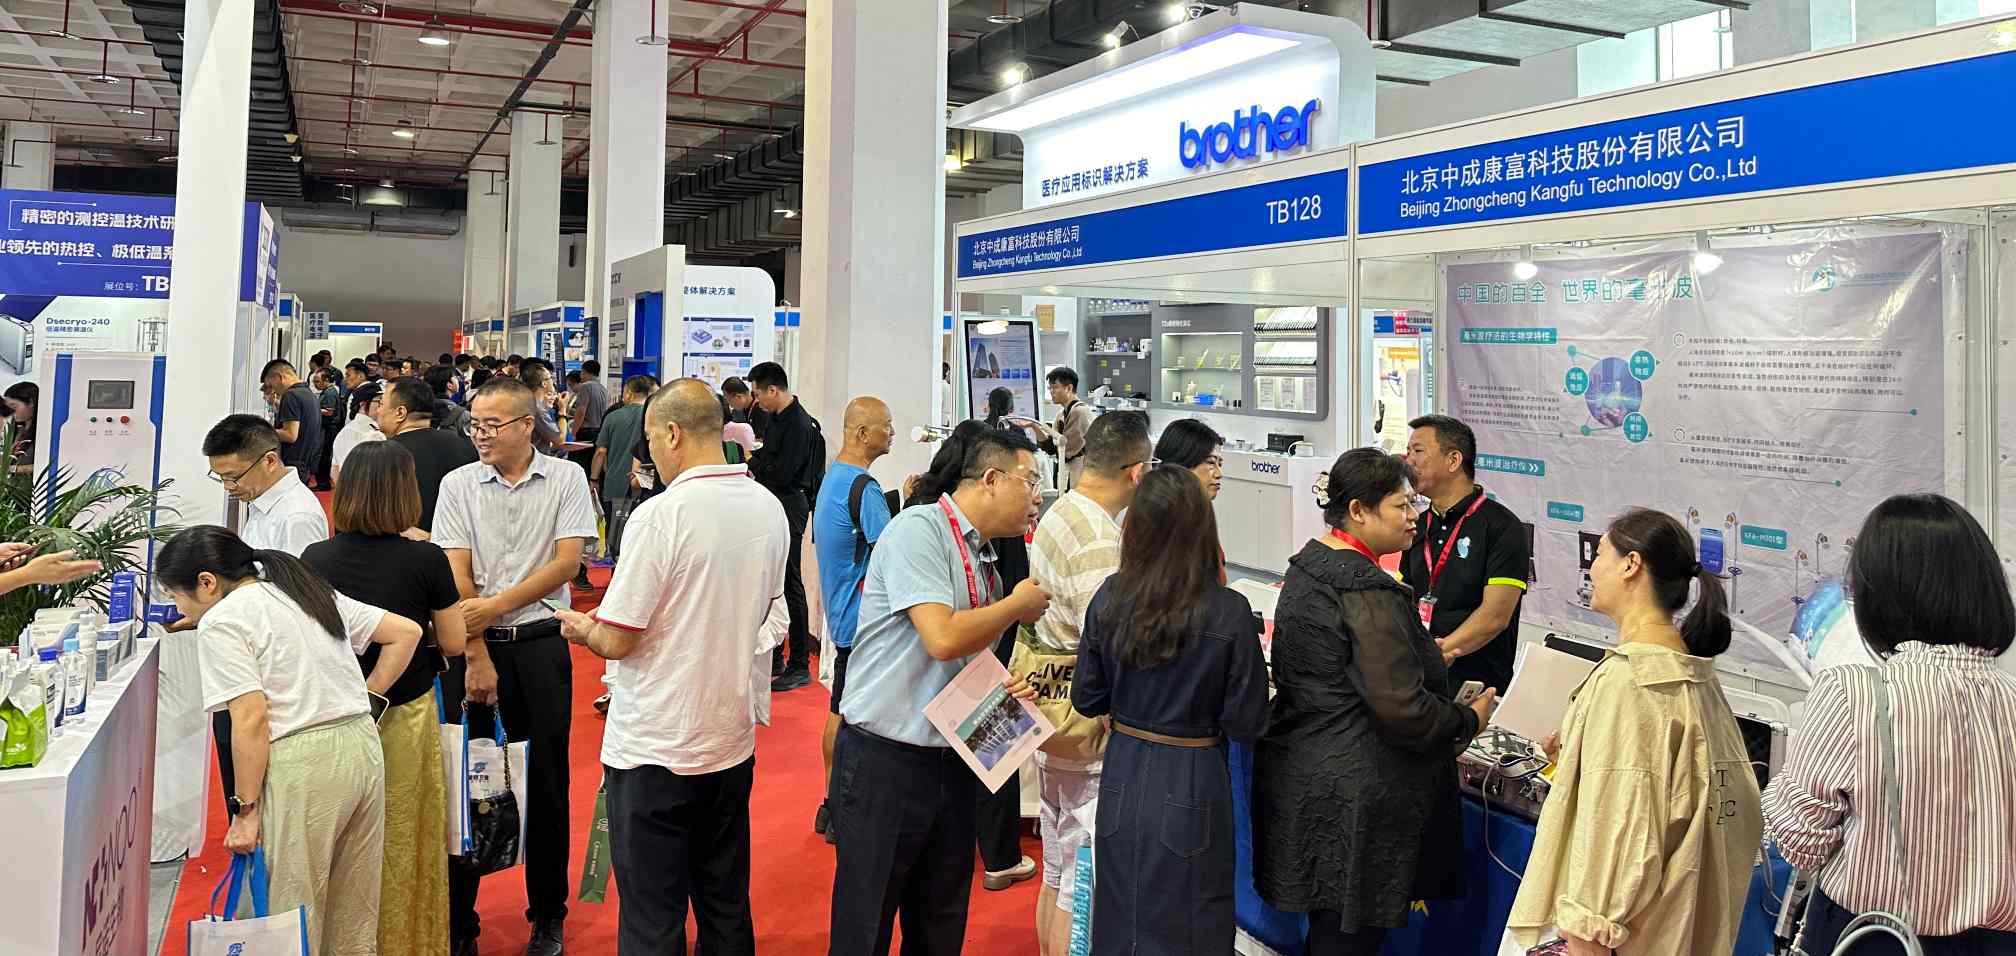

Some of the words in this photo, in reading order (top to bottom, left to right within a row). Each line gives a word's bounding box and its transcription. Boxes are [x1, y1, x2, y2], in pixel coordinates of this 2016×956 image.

[1179, 98, 1321, 169] brother
[1401, 116, 1744, 195] 北京中成康富科技股份有限公司
[1041, 158, 1149, 197] 医疗应用标识解决方案
[1400, 200, 1440, 219] Beijing
[1443, 190, 1526, 212] Zhongcheng
[1530, 179, 1583, 203] Kangfu
[1588, 170, 1683, 194] Technology
[1688, 155, 1757, 182] Co.,Ltd
[1266, 195, 1321, 224] TB128
[974, 225, 1080, 255] 北京中成康富科技股份有限公司
[1251, 460, 1280, 474] brother
